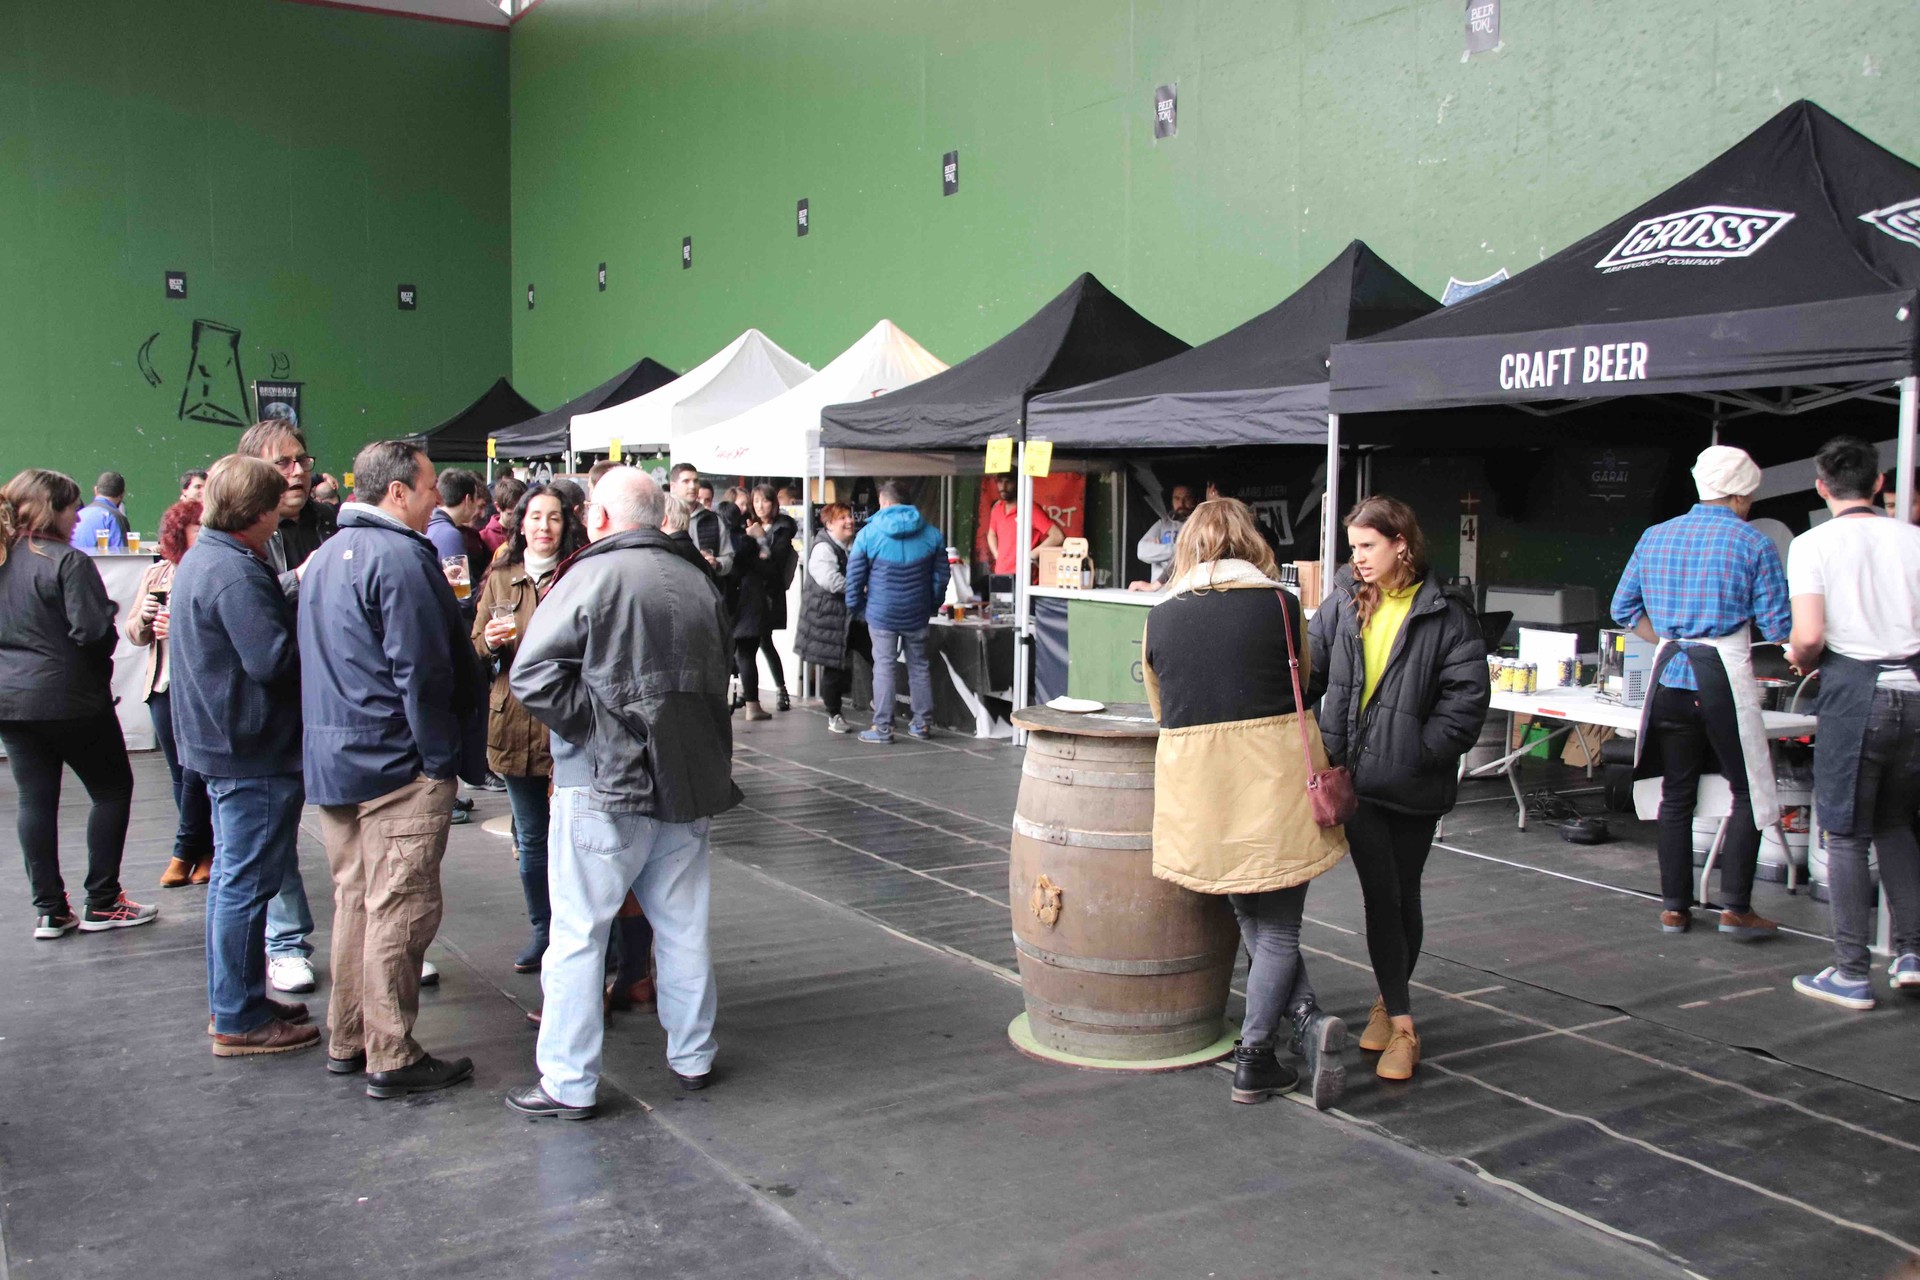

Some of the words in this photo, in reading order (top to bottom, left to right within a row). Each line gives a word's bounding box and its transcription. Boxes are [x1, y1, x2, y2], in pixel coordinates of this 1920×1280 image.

[1471, 4, 1494, 20] BEER
[1471, 17, 1494, 33] TOKI
[1158, 99, 1173, 111] BEER
[1621, 214, 1769, 257] GROSS
[1667, 257, 1725, 266] COMPANY
[1500, 347, 1576, 390] CRAFT
[1583, 342, 1649, 384] BEER
[1461, 518, 1476, 542] 4
